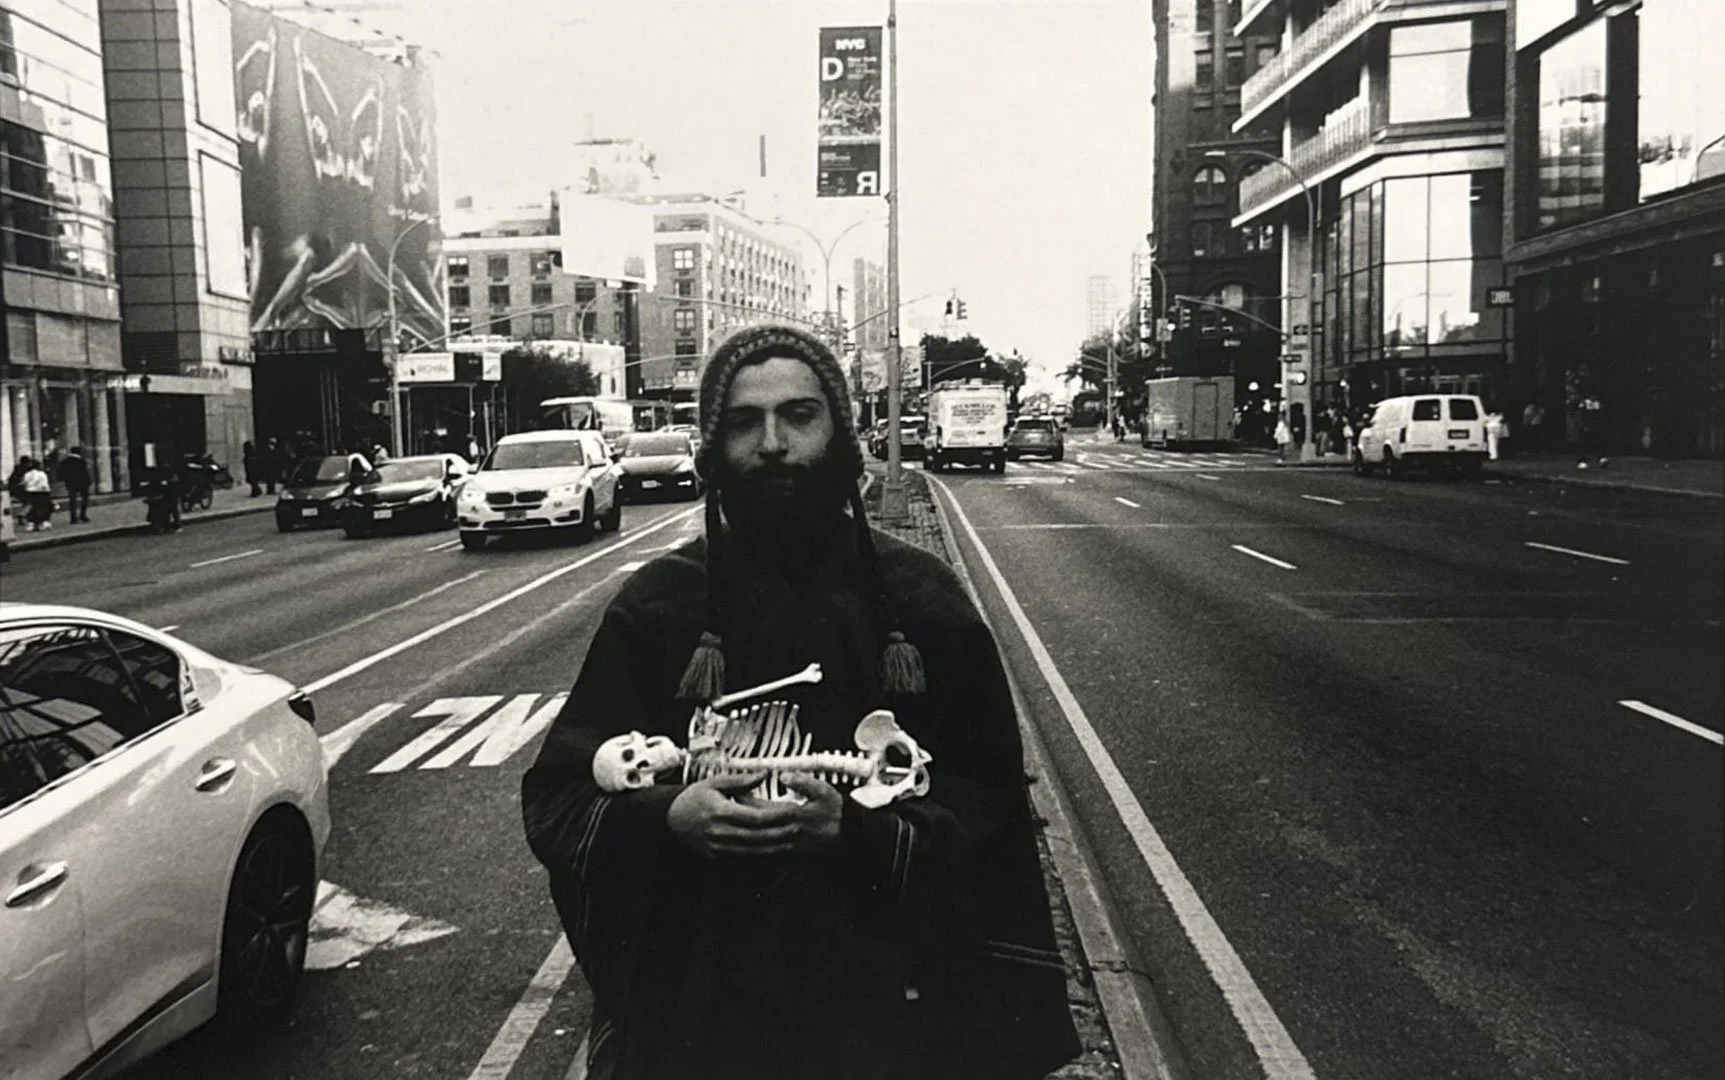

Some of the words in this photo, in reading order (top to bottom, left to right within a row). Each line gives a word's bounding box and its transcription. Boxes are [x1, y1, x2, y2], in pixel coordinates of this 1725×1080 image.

[835, 39, 865, 50] NYC
[822, 57, 844, 80] D
[318, 691, 570, 775] NLY
